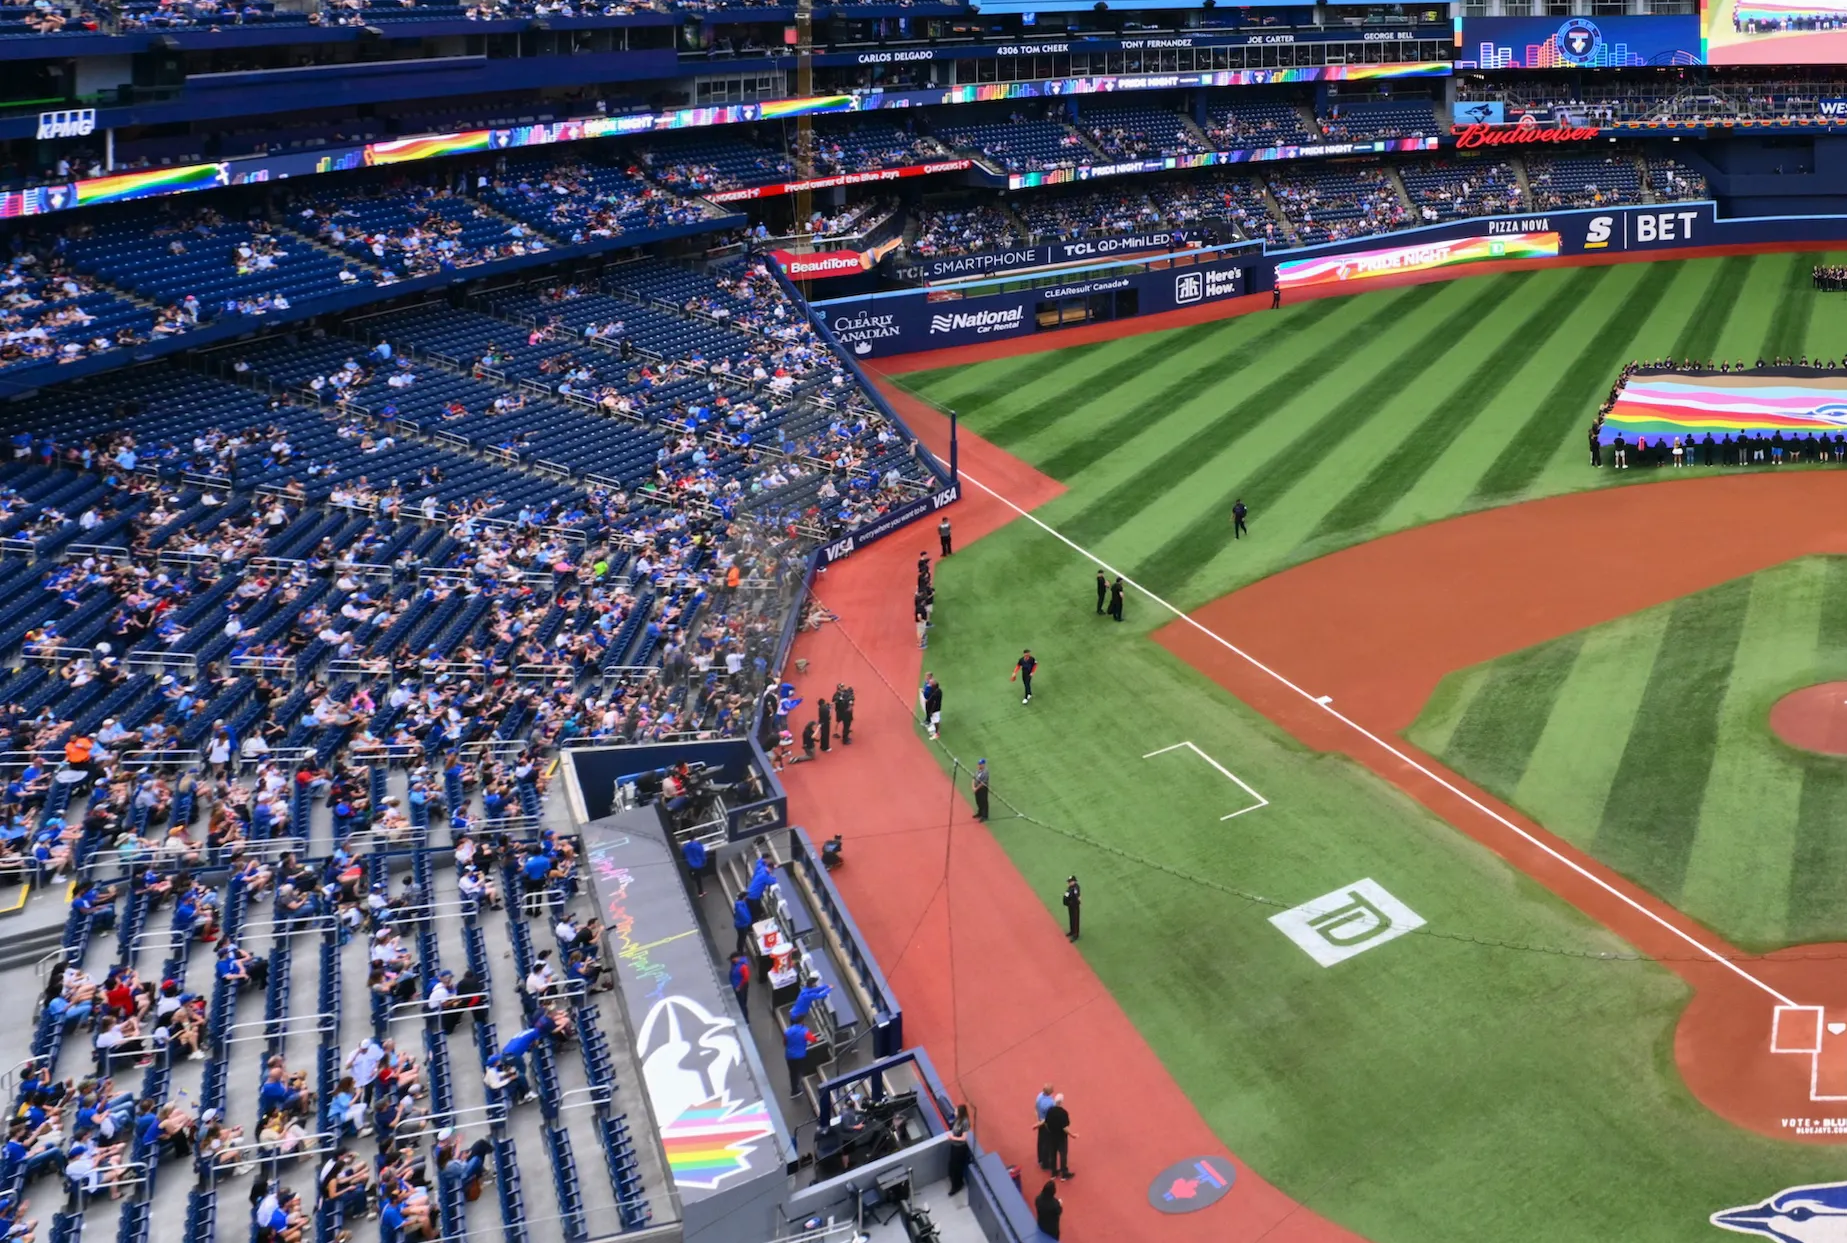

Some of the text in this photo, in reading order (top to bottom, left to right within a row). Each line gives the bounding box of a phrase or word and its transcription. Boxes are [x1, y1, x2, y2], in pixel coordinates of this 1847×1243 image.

[1121, 38, 1192, 49] TONY FERNANDEZ
[1247, 35, 1295, 44] JOE CARTER
[1364, 31, 1414, 40] GEORGE BELL
[858, 50, 933, 64] CARLOS DELGADO
[996, 44, 1069, 55] 4306 TOM CHEEK
[1118, 76, 1179, 89] PRIDE NIGHT
[37, 118, 94, 141] KPMG
[1449, 122, 1600, 149] Budweiser
[1300, 143, 1353, 156] PRIDE NIGHT
[1091, 162, 1143, 176] PRIDE NIGHT
[784, 169, 900, 193] Proud owner of the Blue Jays
[1488, 218, 1549, 235] PIZZA NOVA
[1637, 212, 1698, 243] BET
[1064, 241, 1096, 256] TCL
[791, 255, 858, 274] BeautiTone
[933, 249, 1036, 276] SMARTPHONE
[1357, 254, 1402, 273] PRIDE
[1402, 246, 1451, 267] NIGHT
[1205, 266, 1242, 284] Here's
[1093, 279, 1122, 292] Canada
[1205, 283, 1236, 298] How.
[834, 313, 894, 332] CLEARLY
[977, 320, 1020, 334] Car Rental
[932, 486, 957, 509] VISA
[858, 520, 892, 543] everywhere
[890, 518, 901, 530] you
[900, 510, 915, 523] want
[824, 536, 856, 562] VISA
[1305, 889, 1393, 947] TD
[1781, 1118, 1811, 1128] VOTE
